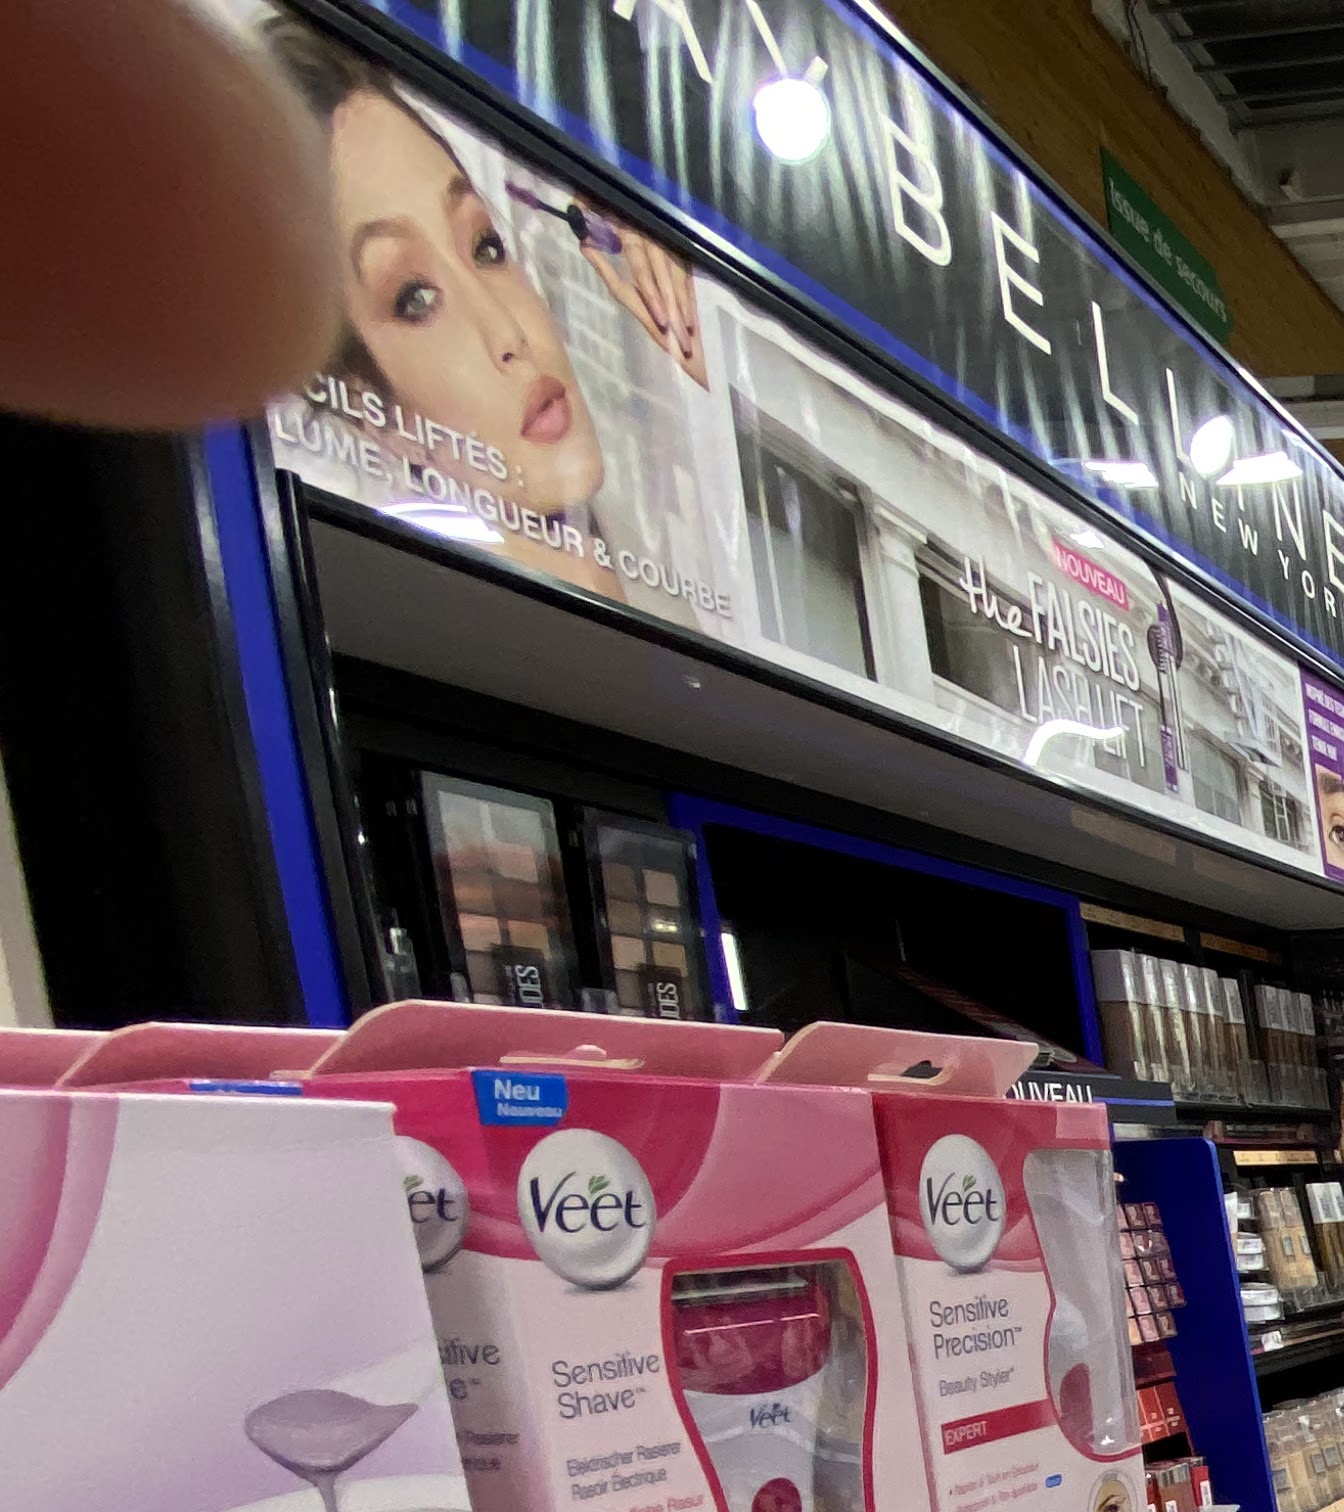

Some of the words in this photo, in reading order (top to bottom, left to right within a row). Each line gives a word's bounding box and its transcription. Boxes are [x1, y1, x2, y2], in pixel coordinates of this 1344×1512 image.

[1108, 176, 1151, 243] Issue
[1152, 227, 1174, 267] de
[304, 371, 388, 429] CILS
[396, 403, 509, 482] LIFTÉS
[402, 457, 587, 559] LONGUEUR
[593, 537, 614, 571] &
[617, 549, 736, 620] COURBE
[1178, 472, 1258, 556] NEW
[1054, 545, 1126, 605] NOUVEAU
[1027, 571, 1141, 692] FALSIES
[493, 1078, 541, 1101] Neu
[406, 1188, 460, 1224] et
[529, 1171, 647, 1234] Veet
[926, 1172, 1000, 1227] Veet
[929, 1294, 1010, 1328] Sensitive
[551, 1351, 661, 1388] Sensitive
[749, 1403, 793, 1429] Veet
[944, 1420, 988, 1446] EXPERT
